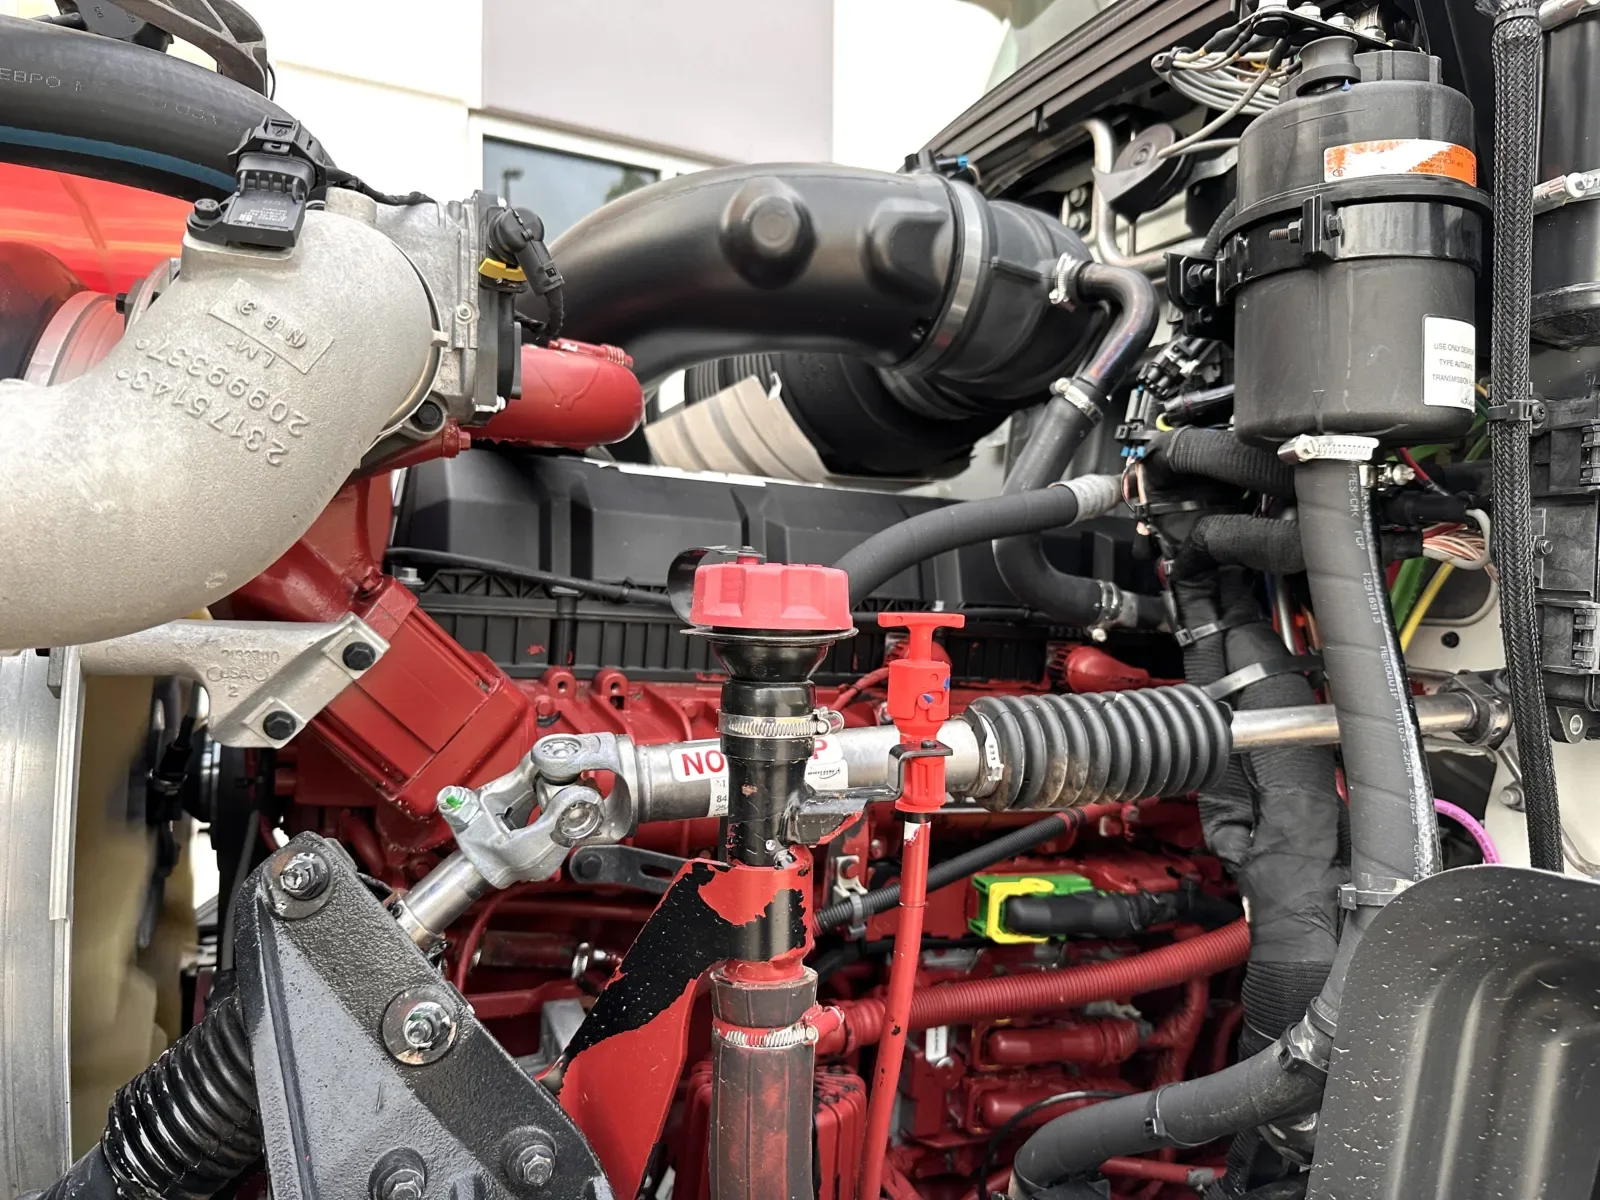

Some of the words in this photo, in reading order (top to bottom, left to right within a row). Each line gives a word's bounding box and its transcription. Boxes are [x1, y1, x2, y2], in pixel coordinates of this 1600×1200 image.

[1433, 342, 1447, 351] USE
[1447, 343, 1460, 353] ONLY
[1438, 358, 1454, 367] TYPE
[1353, 530, 1365, 550] FCP
[681, 749, 725, 776] NO
